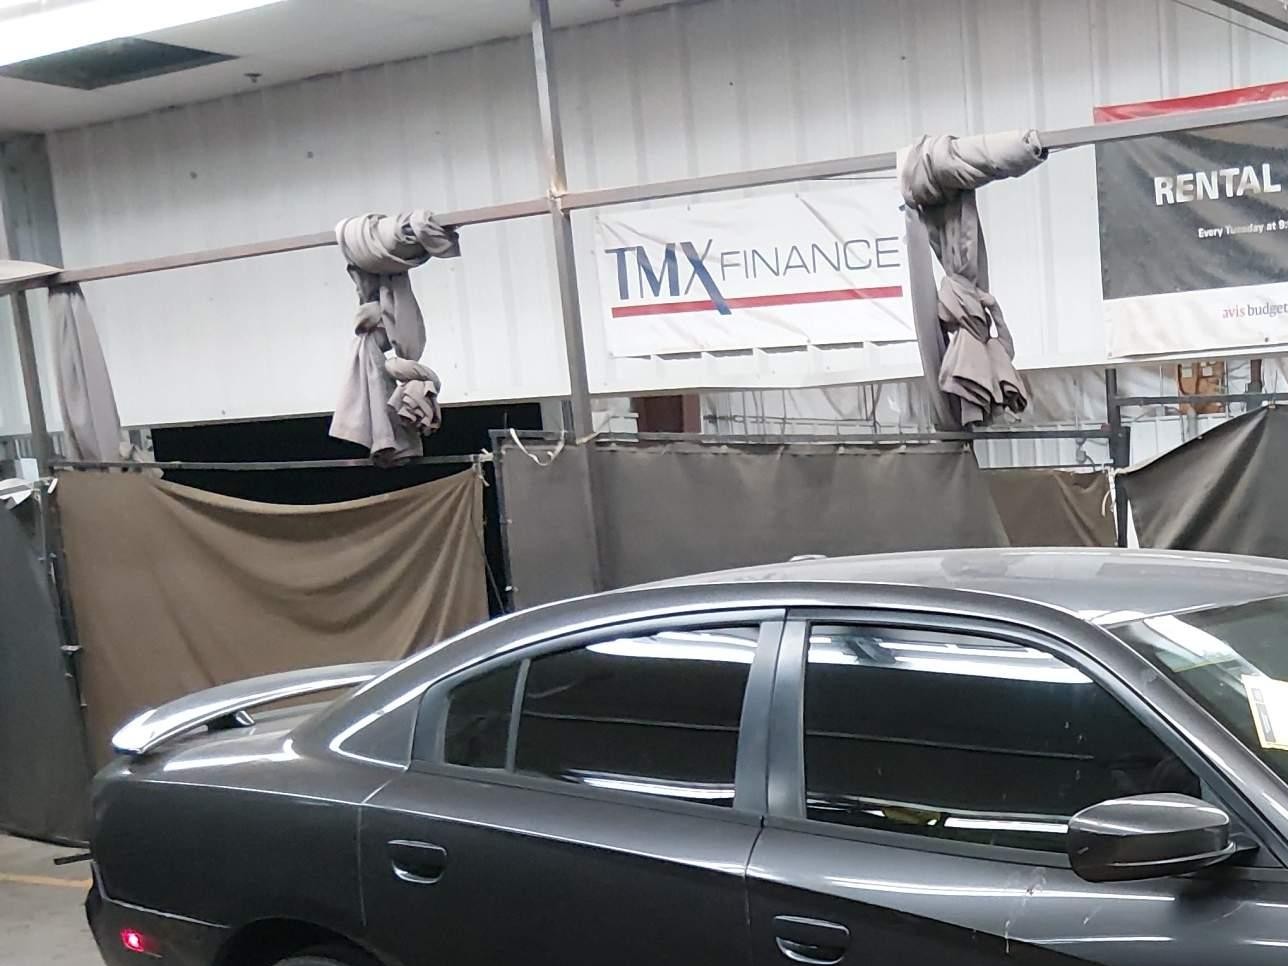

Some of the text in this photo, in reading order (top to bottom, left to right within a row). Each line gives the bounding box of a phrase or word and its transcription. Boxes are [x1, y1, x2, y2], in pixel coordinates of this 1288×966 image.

[1154, 163, 1282, 206] RENTAL
[1197, 227, 1224, 239] Every
[1266, 221, 1277, 231] at
[604, 236, 902, 315] TMX FINANCE
[1222, 305, 1246, 319] avis
[1247, 301, 1288, 318] budget
